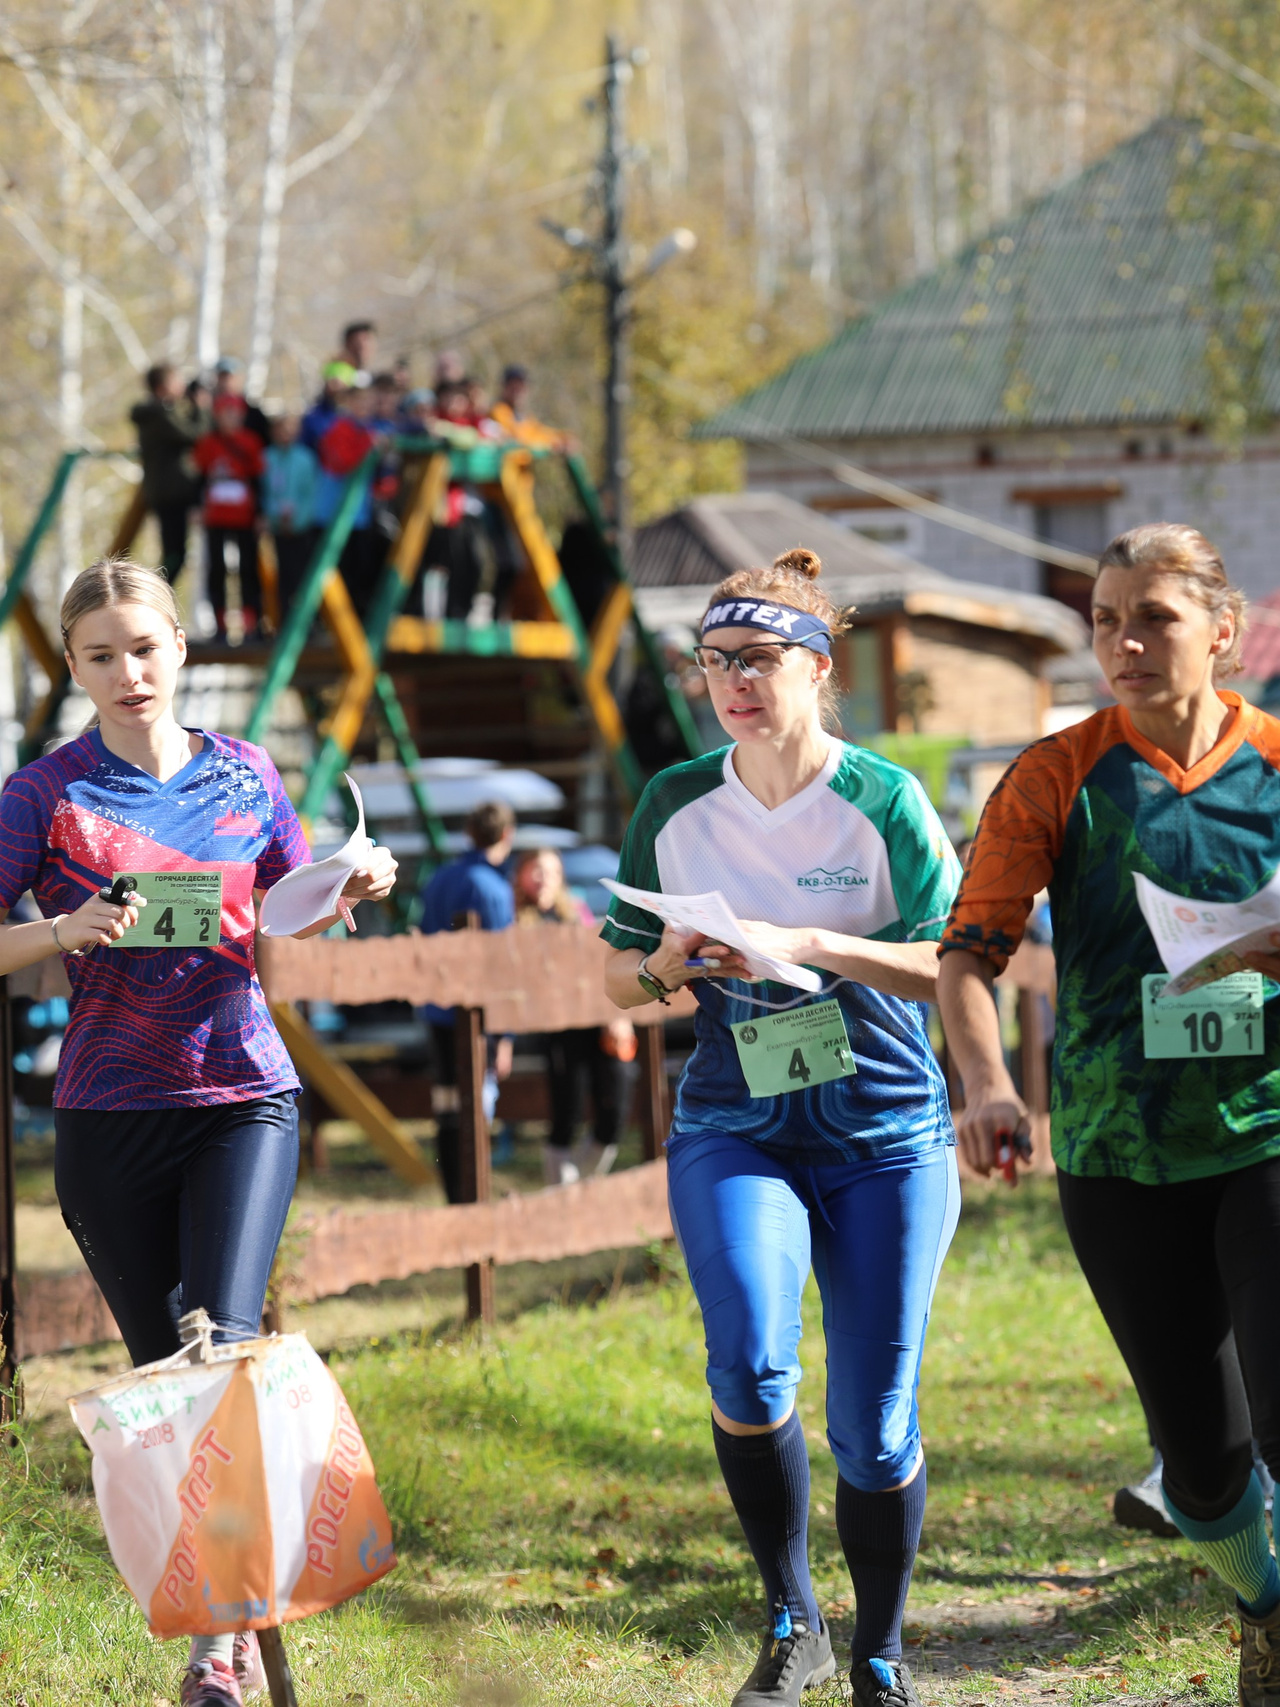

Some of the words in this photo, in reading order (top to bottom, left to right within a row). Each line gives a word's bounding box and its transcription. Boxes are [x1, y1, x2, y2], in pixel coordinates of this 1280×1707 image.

[797, 876, 869, 887] EKB-O-TEAM
[147, 897, 198, 905] катеринбург-2
[193, 908, 218, 916] ЭТАП
[153, 907, 175, 942] 4
[199, 916, 210, 941] 2
[772, 1012, 805, 1026] ГОРЯЧАЯ
[805, 1003, 838, 1018] ДЕСЯТКА
[1234, 1012, 1261, 1020] ЭТАП
[822, 1035, 847, 1049] ЭТАП
[1183, 1011, 1223, 1052] 10
[1244, 1023, 1253, 1050] 1
[788, 1047, 811, 1084] 4
[834, 1047, 847, 1072] 1
